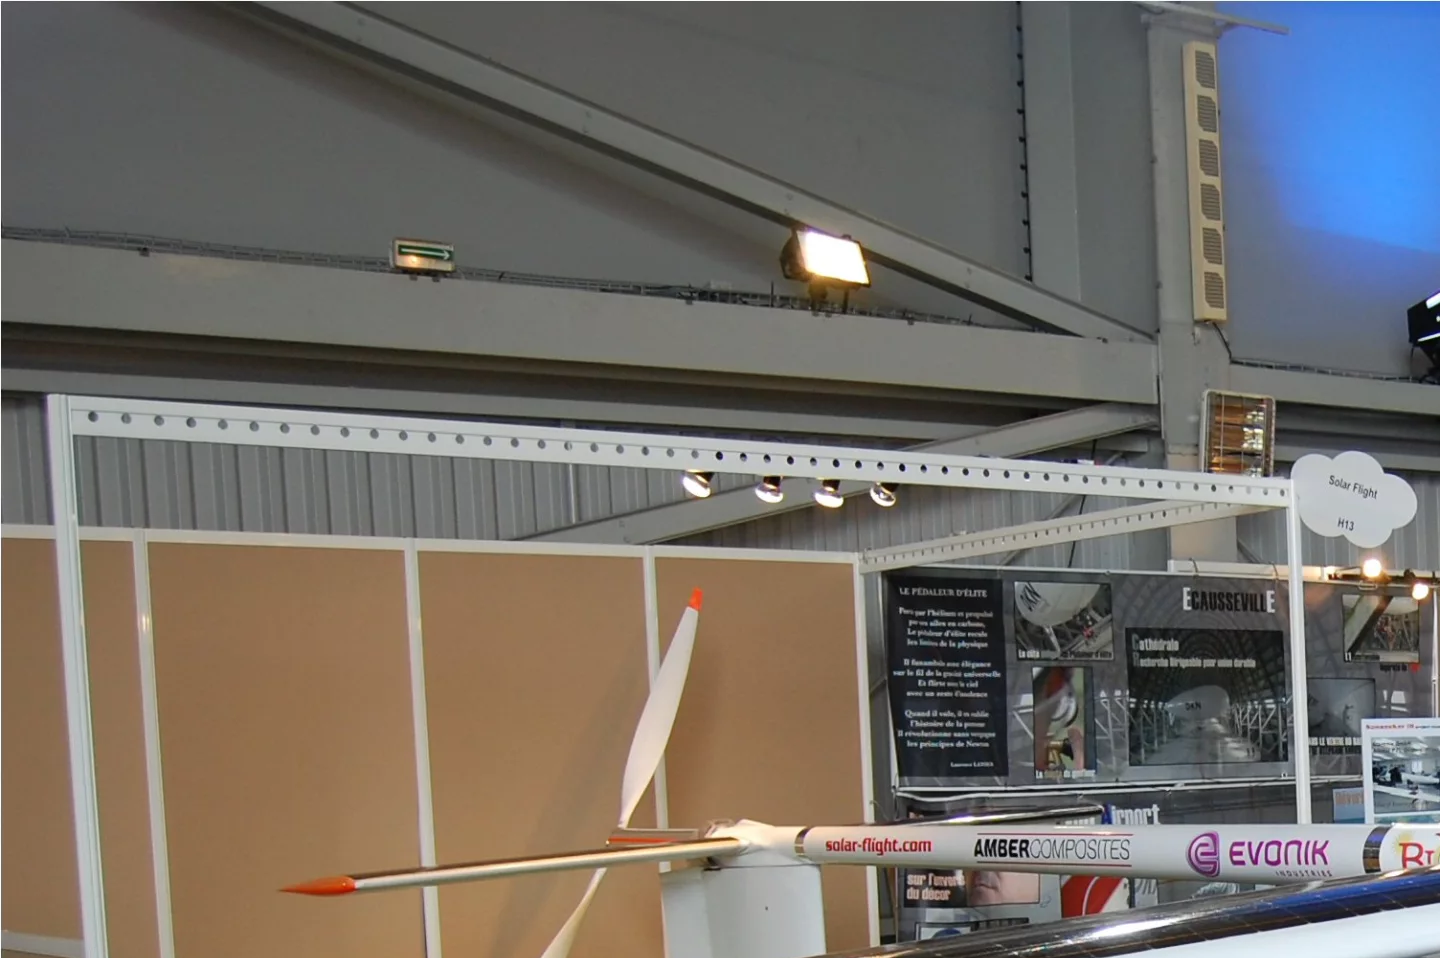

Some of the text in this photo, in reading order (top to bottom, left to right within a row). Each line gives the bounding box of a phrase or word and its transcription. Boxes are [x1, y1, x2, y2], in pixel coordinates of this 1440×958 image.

[1329, 475, 1377, 499] Solar Flight
[1337, 517, 1354, 531] H13
[911, 586, 955, 597] PÉDALEUR
[956, 588, 987, 598] D'ÉLITE
[1182, 587, 1276, 613] ECAUSSEVILLE
[825, 837, 932, 856] solar-flight.com
[1229, 840, 1330, 867] EVONIK
[907, 874, 926, 886] sur
[906, 887, 951, 901] du décor
